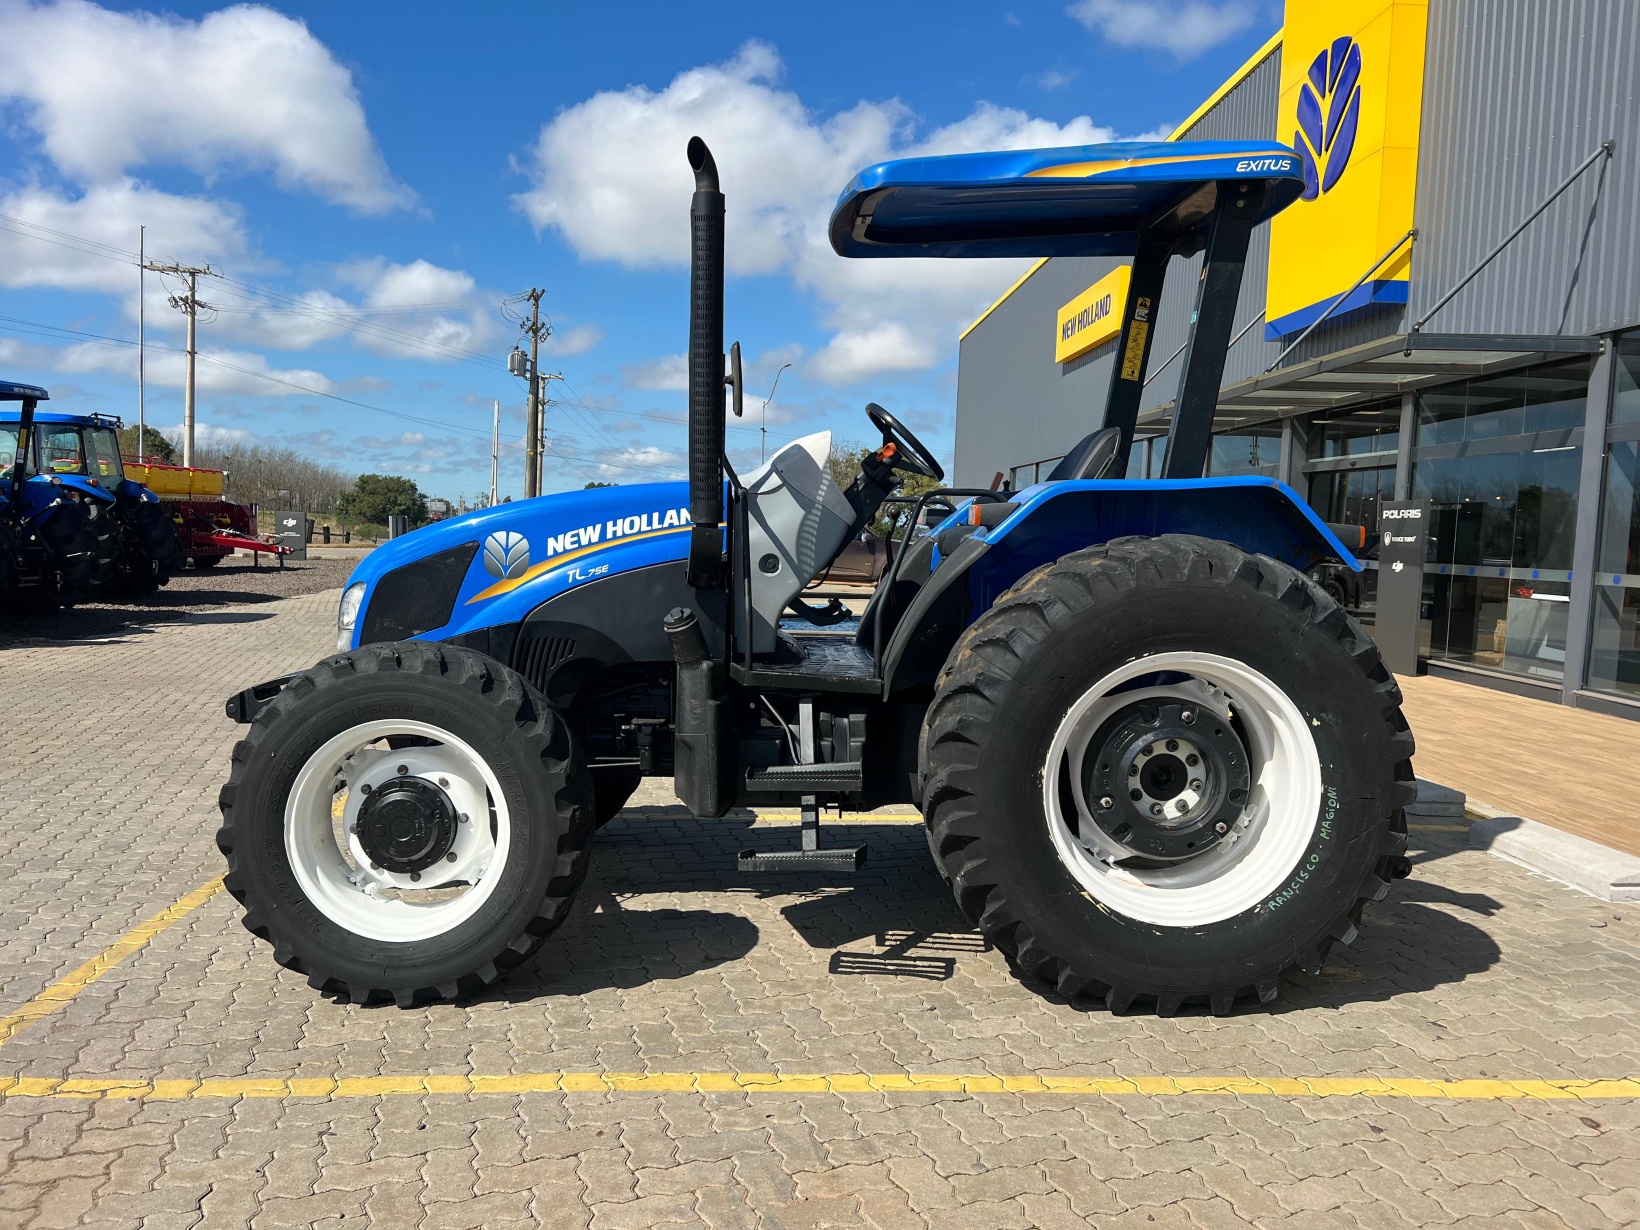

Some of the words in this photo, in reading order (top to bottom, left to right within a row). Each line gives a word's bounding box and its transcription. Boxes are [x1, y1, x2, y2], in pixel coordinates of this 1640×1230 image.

[1236, 159, 1291, 172] EXITUS
[1062, 314, 1077, 342] NEW
[1077, 293, 1111, 332] HOLLAND
[1383, 509, 1422, 519] POLARIS
[283, 517, 297, 527] dji
[547, 523, 602, 557] NEW
[606, 507, 693, 540] HOLLAN
